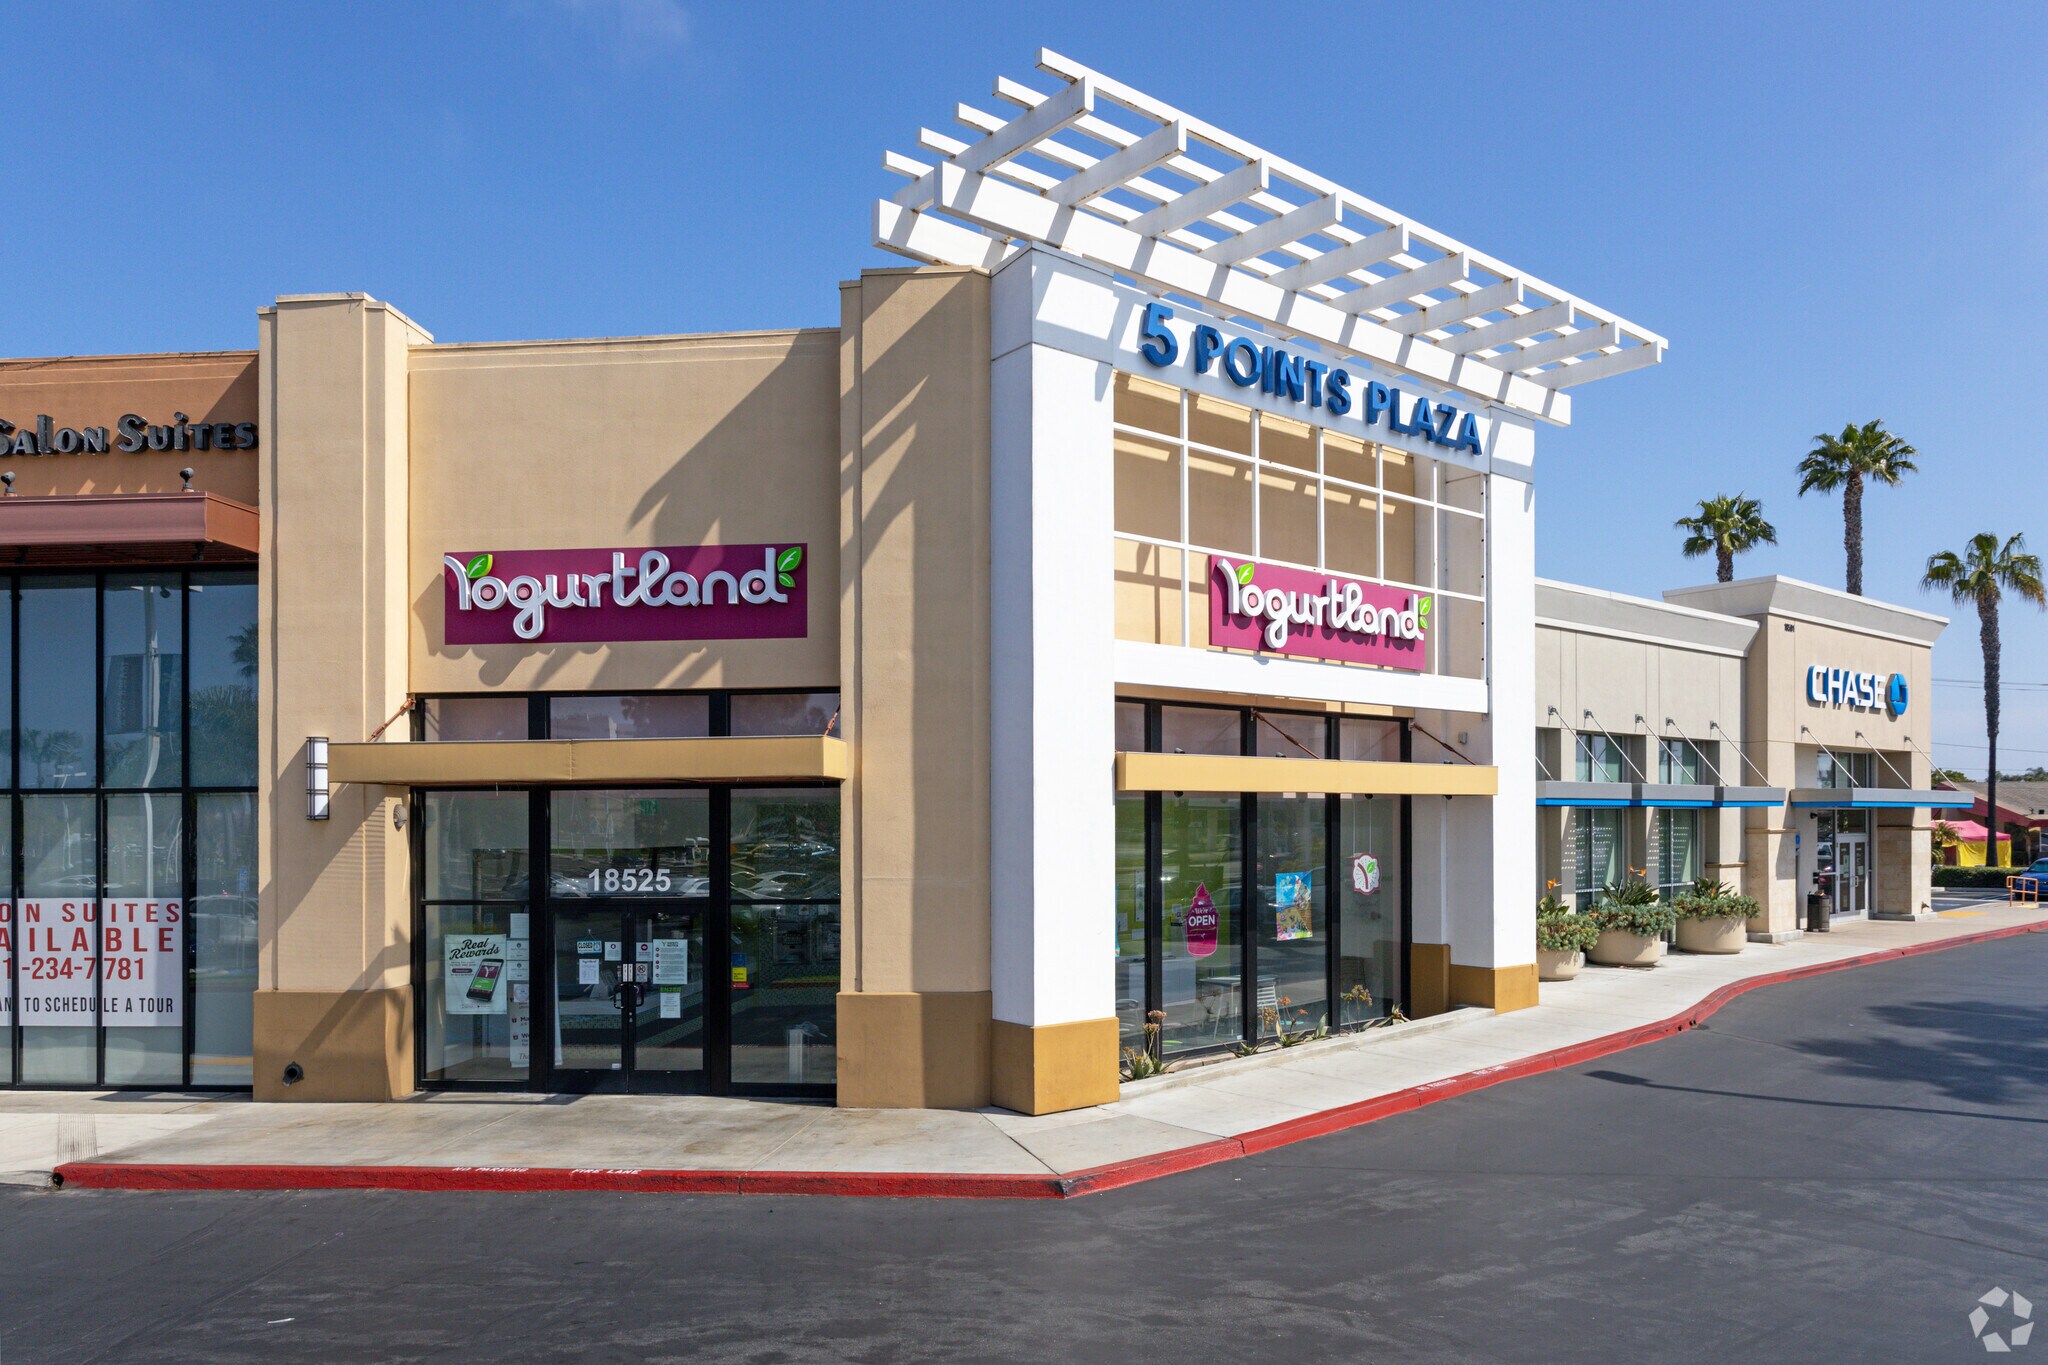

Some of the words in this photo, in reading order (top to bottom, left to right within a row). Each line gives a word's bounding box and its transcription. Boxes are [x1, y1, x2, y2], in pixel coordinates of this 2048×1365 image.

[1141, 302, 1179, 367] 5
[1195, 323, 1352, 416] POINTS
[1367, 380, 1483, 456] PLAZA
[444, 547, 789, 640] Yogurtland
[1217, 558, 1425, 649] Yogurtland
[1806, 664, 1887, 709] CHASE
[588, 868, 671, 892] 18525
[62, 903, 180, 923] SUITES
[1188, 915, 1216, 927] OPEN
[449, 944, 501, 960] Rewards
[461, 938, 489, 951] Real
[24, 997, 40, 1013] TO
[45, 997, 118, 1013] SCHEDULE
[125, 997, 133, 1013] A
[139, 997, 174, 1013] TOUR
